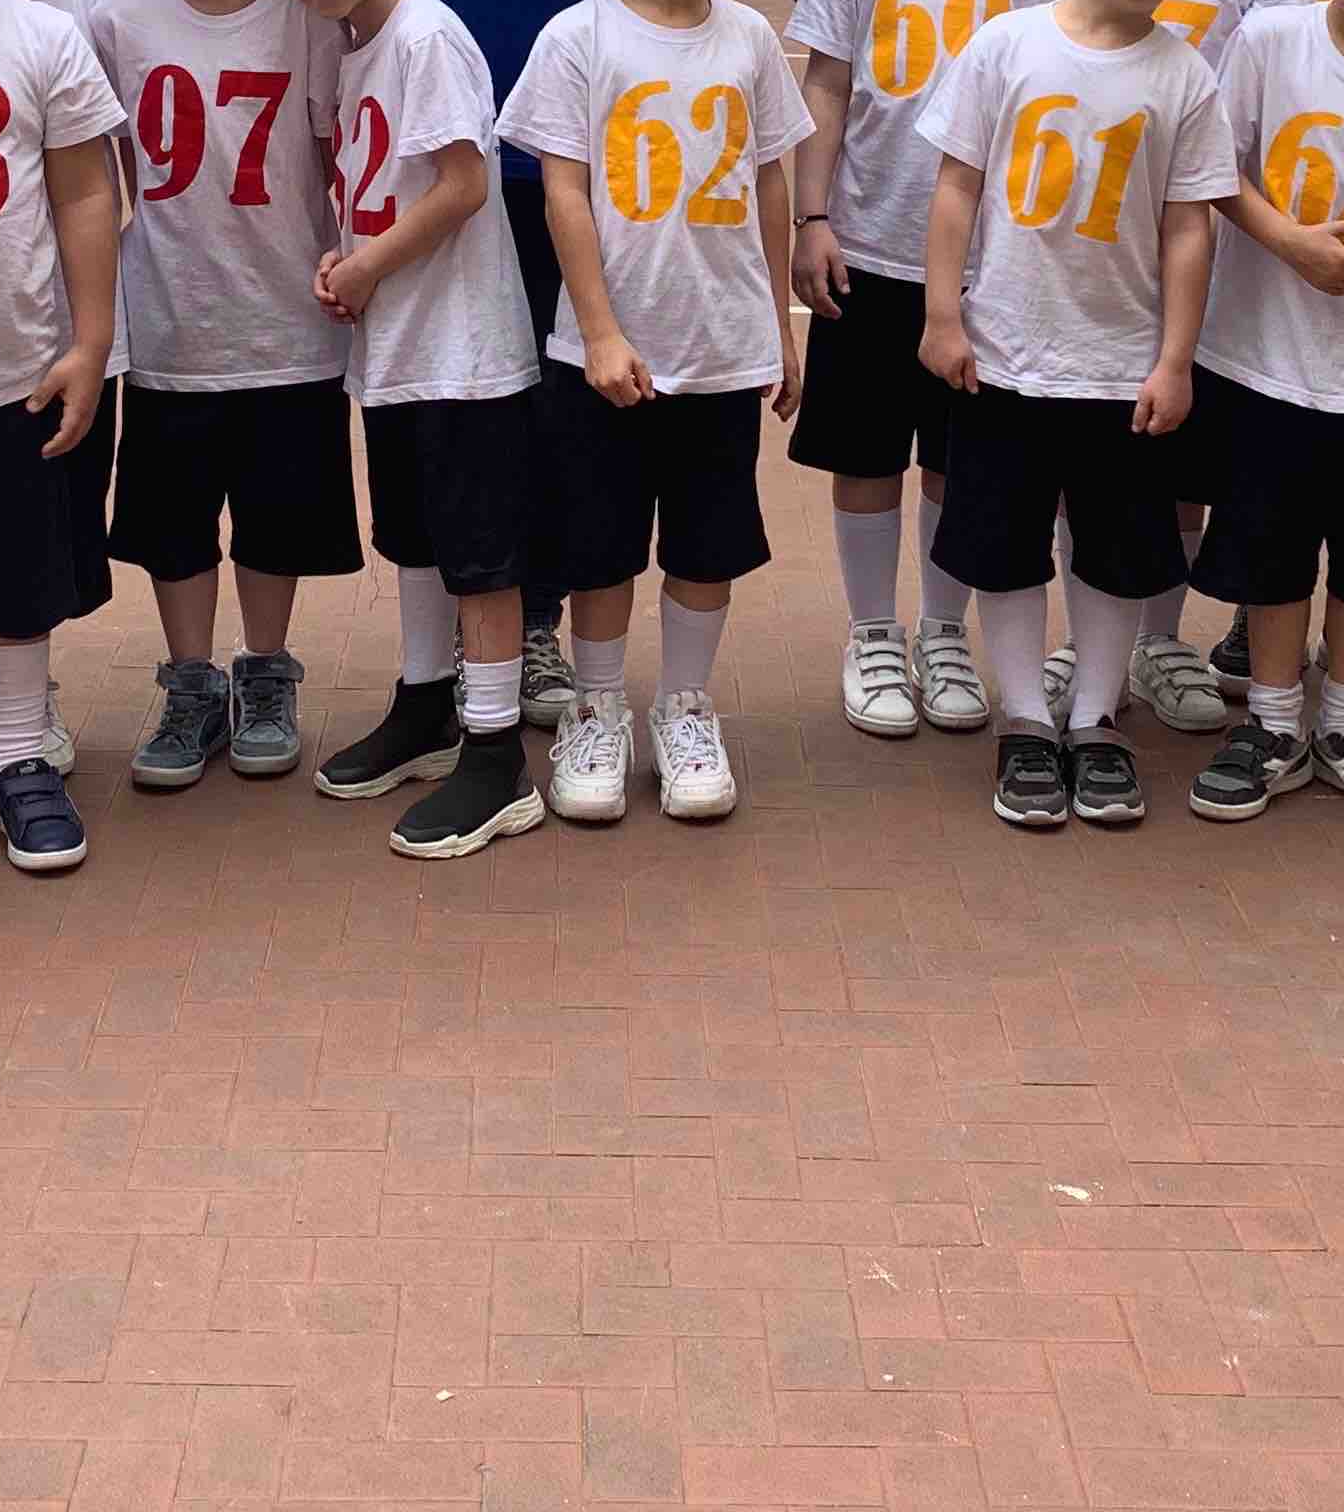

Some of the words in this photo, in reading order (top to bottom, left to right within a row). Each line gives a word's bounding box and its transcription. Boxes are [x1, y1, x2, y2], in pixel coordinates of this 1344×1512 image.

[136, 63, 292, 207] 97
[330, 95, 397, 238] 2
[605, 79, 749, 228] 62
[1006, 93, 1147, 245] 61
